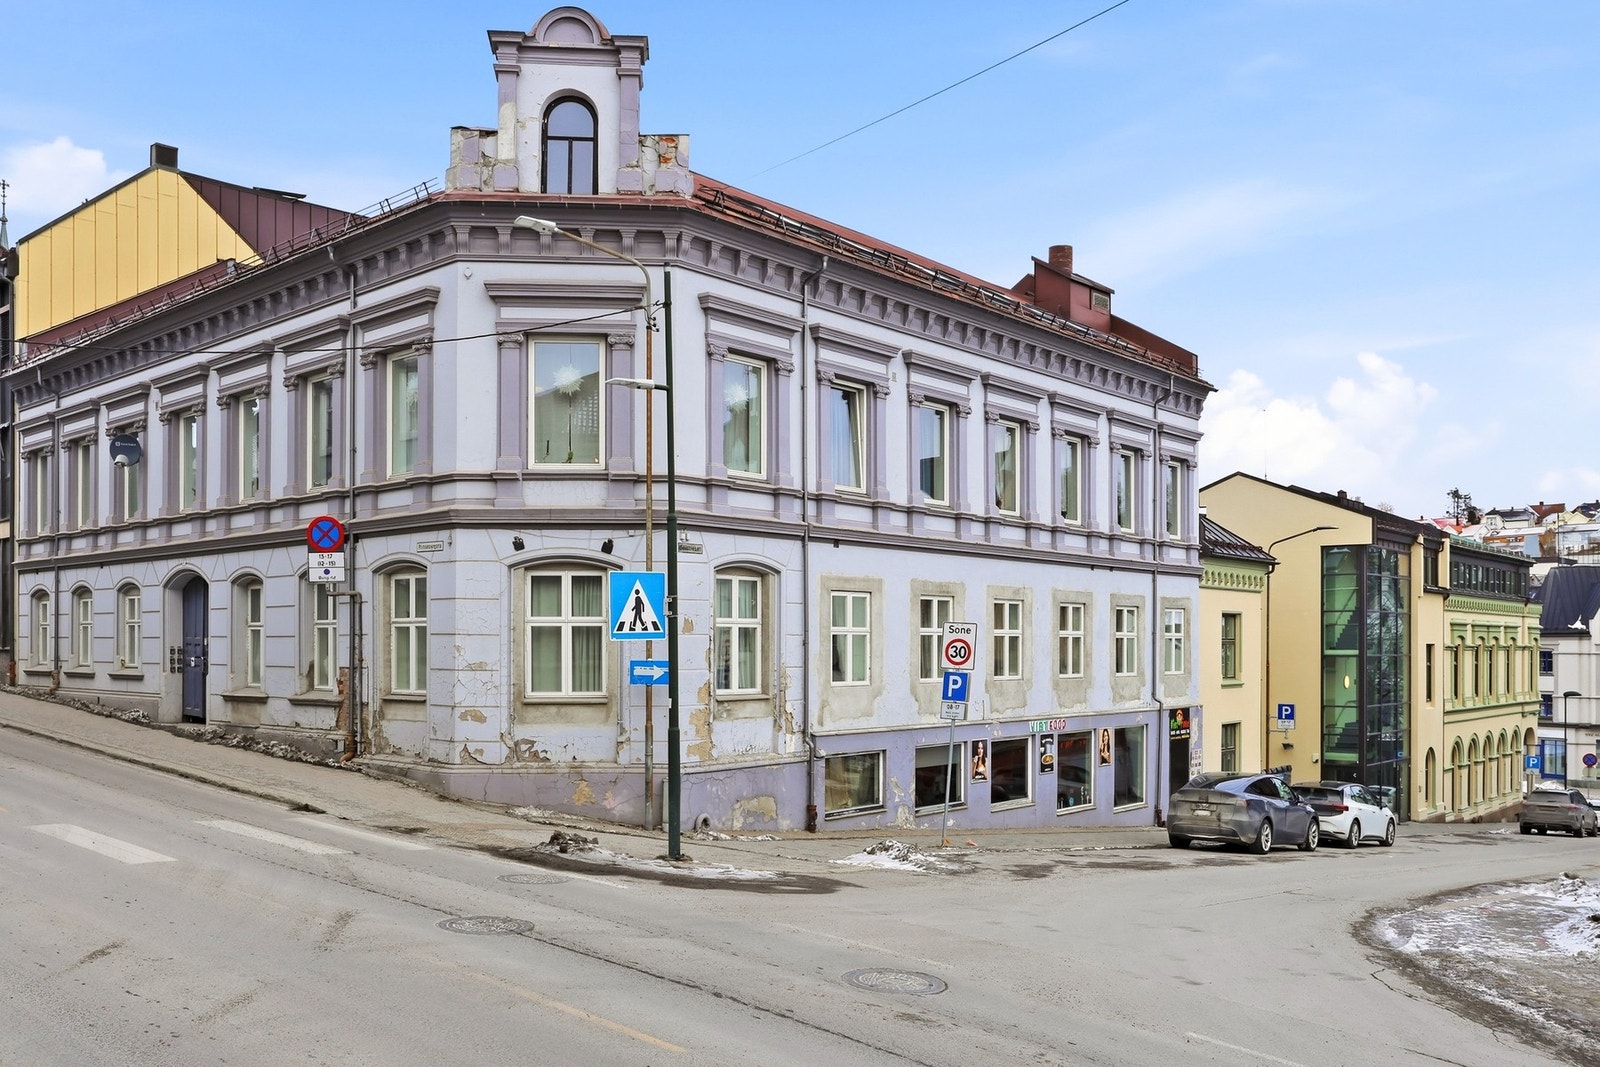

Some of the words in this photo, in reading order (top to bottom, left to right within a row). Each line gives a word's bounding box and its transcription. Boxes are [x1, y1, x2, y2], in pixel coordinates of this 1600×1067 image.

[948, 625, 971, 634] Sone
[949, 645, 967, 658] 30
[948, 676, 962, 697] P
[1282, 706, 1291, 718] P
[1530, 758, 1538, 767] P
